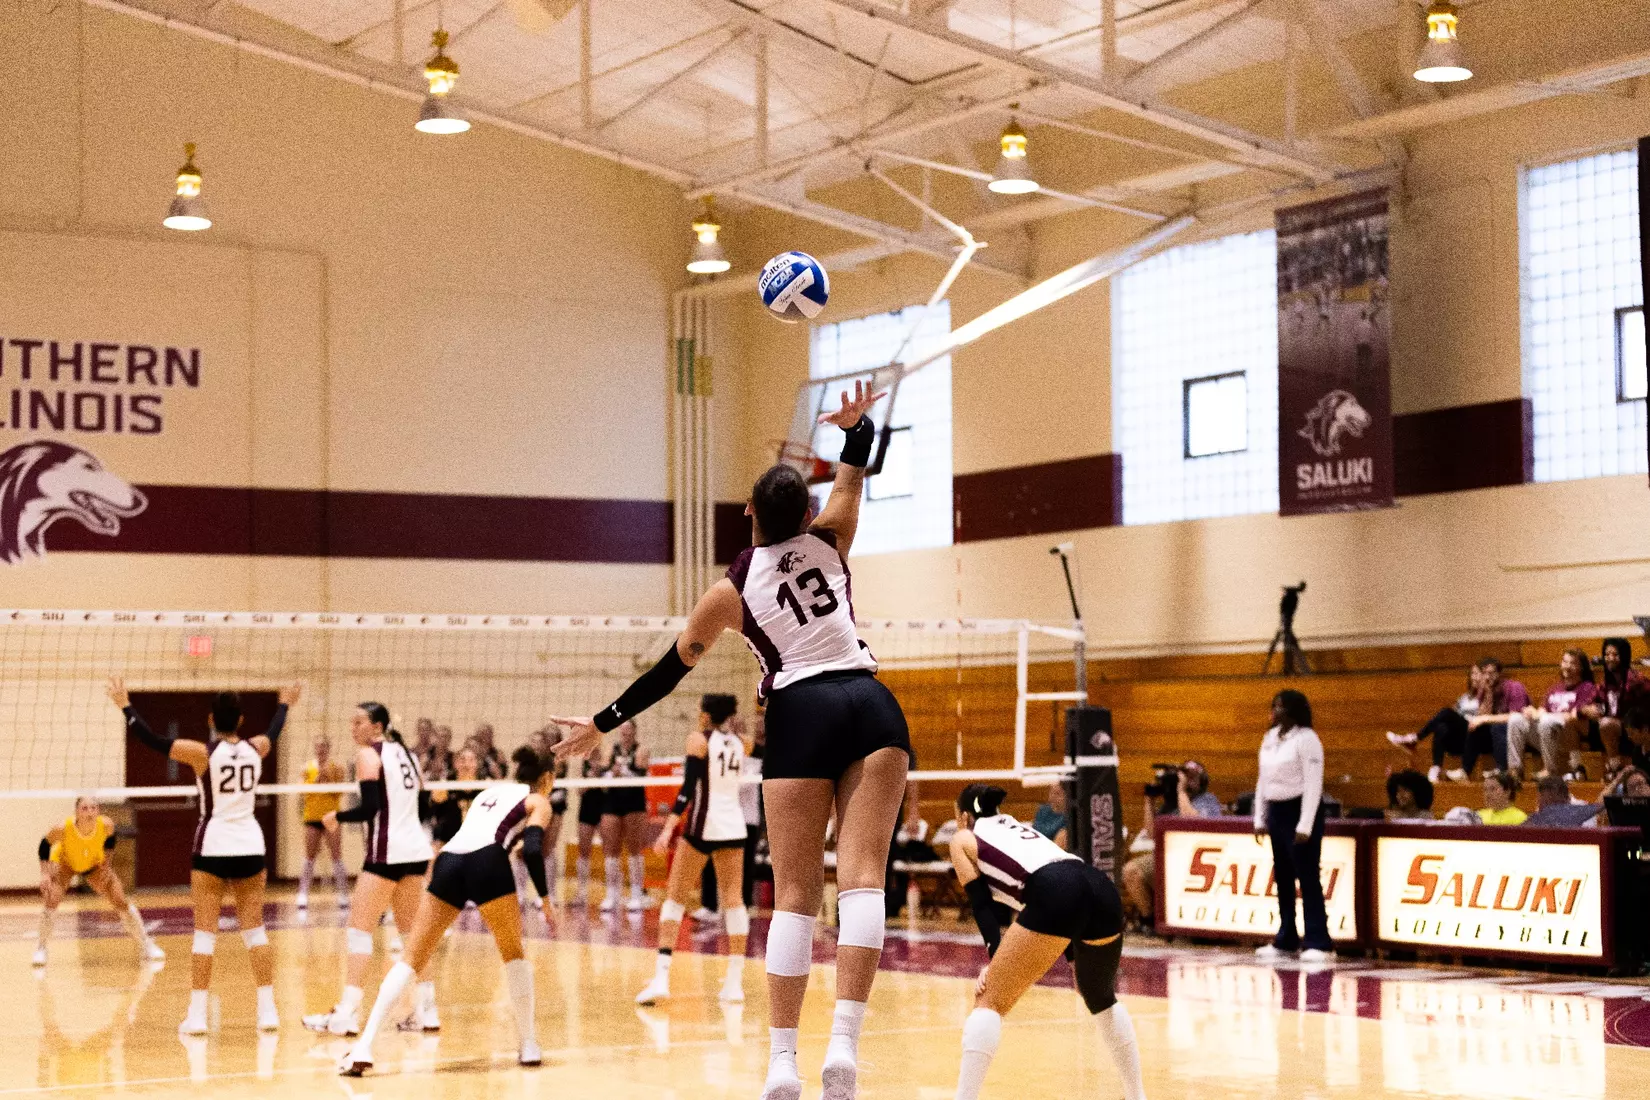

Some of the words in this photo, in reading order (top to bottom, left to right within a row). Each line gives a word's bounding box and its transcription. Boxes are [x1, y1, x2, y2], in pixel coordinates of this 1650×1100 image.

[760, 258, 791, 290] molten
[0, 337, 200, 387] THERN
[0, 388, 163, 434] INOIS
[1296, 457, 1374, 490] SALUKI
[775, 567, 839, 627] 13
[219, 764, 255, 793] 20
[400, 763, 415, 790] 8
[717, 751, 740, 777] 14
[480, 798, 498, 812] 4
[1400, 854, 1583, 916] SALUKI
